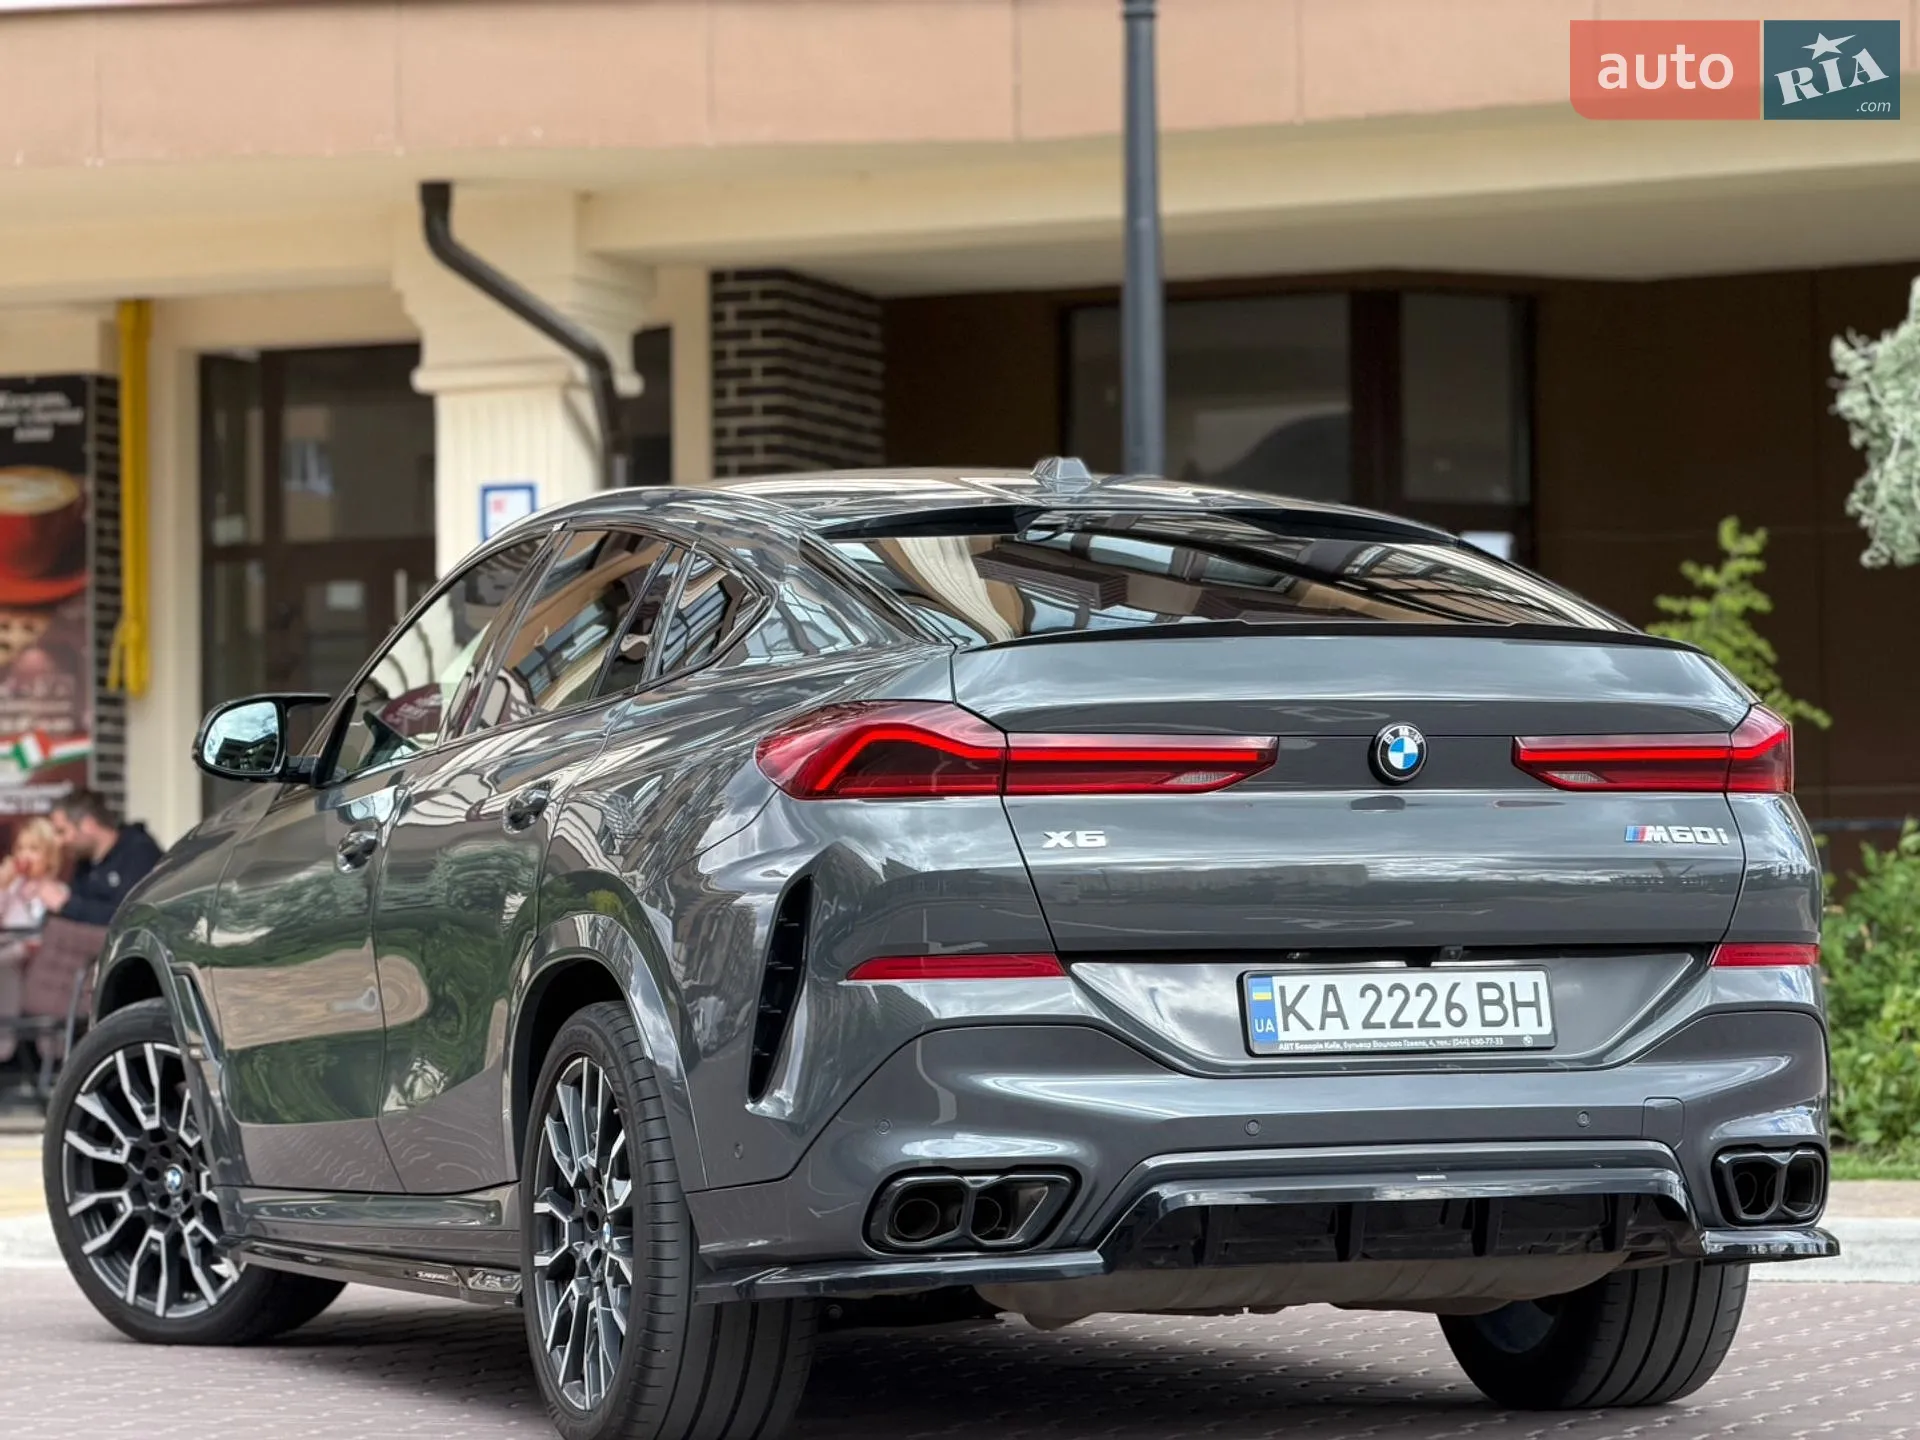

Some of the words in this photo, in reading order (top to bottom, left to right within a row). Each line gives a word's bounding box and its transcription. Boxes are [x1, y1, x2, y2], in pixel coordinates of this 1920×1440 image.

[1382, 726, 1424, 745] BMW
[1042, 830, 1107, 850] X6
[1641, 825, 1729, 846] M60i
[1279, 983, 1350, 1032] KA
[1359, 982, 1468, 1030] 2226
[1475, 981, 1543, 1028] BH
[1254, 1018, 1276, 1033] UA
